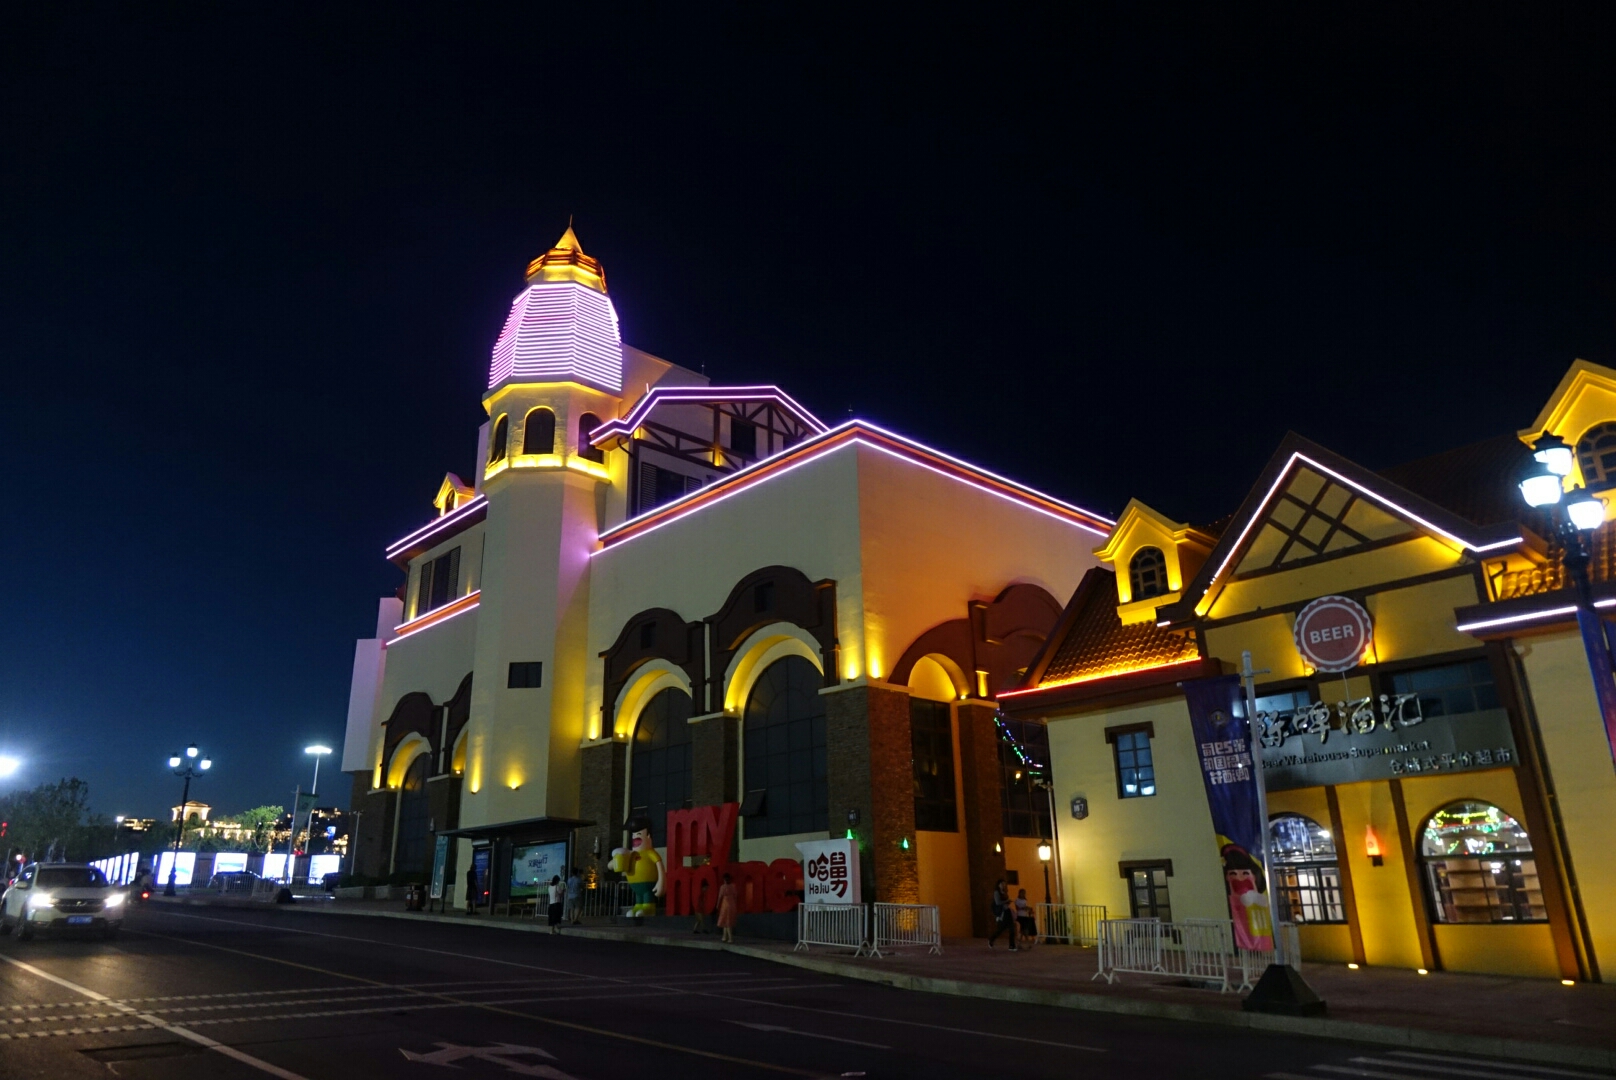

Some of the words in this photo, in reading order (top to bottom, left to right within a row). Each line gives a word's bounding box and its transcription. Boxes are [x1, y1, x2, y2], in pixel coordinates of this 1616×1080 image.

[1310, 624, 1354, 644] BEER
[1284, 751, 1349, 768] Warehouse
[1350, 740, 1431, 760] Supermarket
[1390, 747, 1512, 774] 仓储式平价超市
